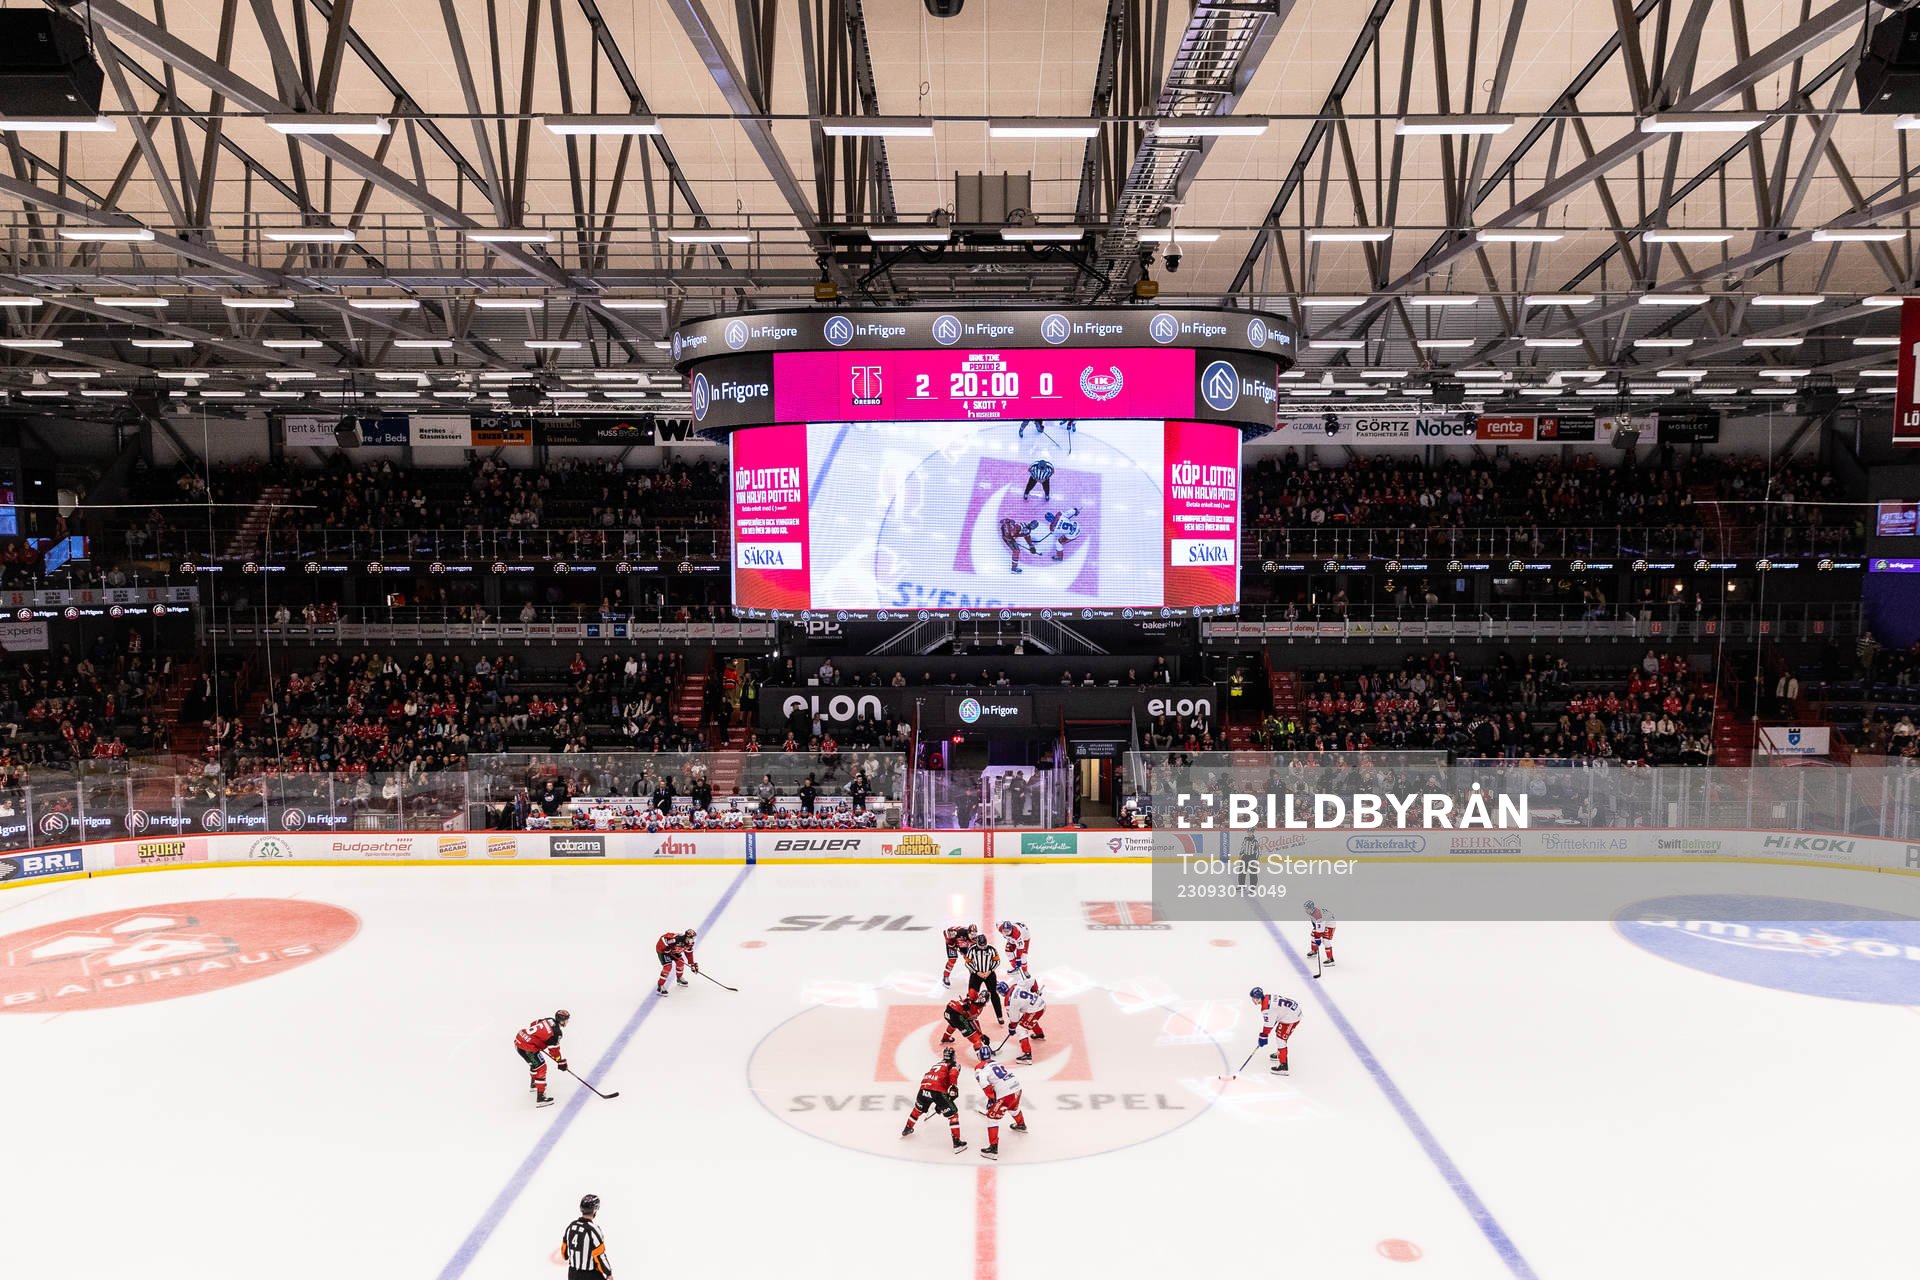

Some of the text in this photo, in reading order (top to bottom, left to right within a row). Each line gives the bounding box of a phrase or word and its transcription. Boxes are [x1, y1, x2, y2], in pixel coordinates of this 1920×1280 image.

[752, 326, 797, 340] In Frigore
[856, 325, 905, 338] In Frigore
[965, 324, 1014, 336] In Frigore
[1074, 323, 1122, 336] In Frigore
[1182, 324, 1226, 337] In Frigore
[916, 374, 930, 396] 2
[950, 373, 1018, 396] 20:00
[1040, 373, 1053, 396] 0
[711, 380, 769, 403] In Frigore
[1243, 380, 1276, 404] In Frigore
[973, 400, 996, 409] SKOTT
[288, 424, 307, 432] rent
[310, 424, 316, 432] &
[1356, 419, 1409, 431] GÖRTZ
[1487, 421, 1523, 432] renta
[385, 434, 407, 442] Beds
[736, 466, 800, 490] KÖP LOTTEN
[1171, 460, 1235, 488] KÖP LOTTEN
[768, 489, 800, 503] POTTEN
[1172, 486, 1193, 499] VINN
[1195, 486, 1217, 500] HALVA
[744, 547, 784, 565] SÄKRA
[1189, 543, 1228, 562] SÄKRA
[1294, 625, 1315, 633] dormy
[982, 705, 1018, 717] In Frigore
[228, 816, 266, 826] In Frigore
[308, 815, 347, 826] In Frigore
[554, 841, 600, 851] colorama
[775, 840, 861, 851] BAUER
[902, 835, 930, 845] EURO
[1355, 840, 1417, 849] Närkefrakt
[1451, 837, 1503, 848] BEHRN
[1546, 838, 1627, 850] Driftteknik AB
[1658, 839, 1721, 850] SwiftDelivery
[1764, 835, 1856, 853] HiKOKI
[138, 842, 185, 858] SPORT
[333, 842, 412, 853] Budpartner
[439, 845, 466, 853] BAGARN
[488, 845, 516, 853] BAGARN
[894, 845, 938, 855] JACKPOT
[1125, 844, 1174, 852] Värmepumpar
[23, 853, 79, 871] BRL
[767, 915, 934, 931] SHL
[2, 944, 314, 1007] BAUHAUS
[1054, 1094, 1185, 1111] SPEL
[572, 1234, 578, 1248] 4
